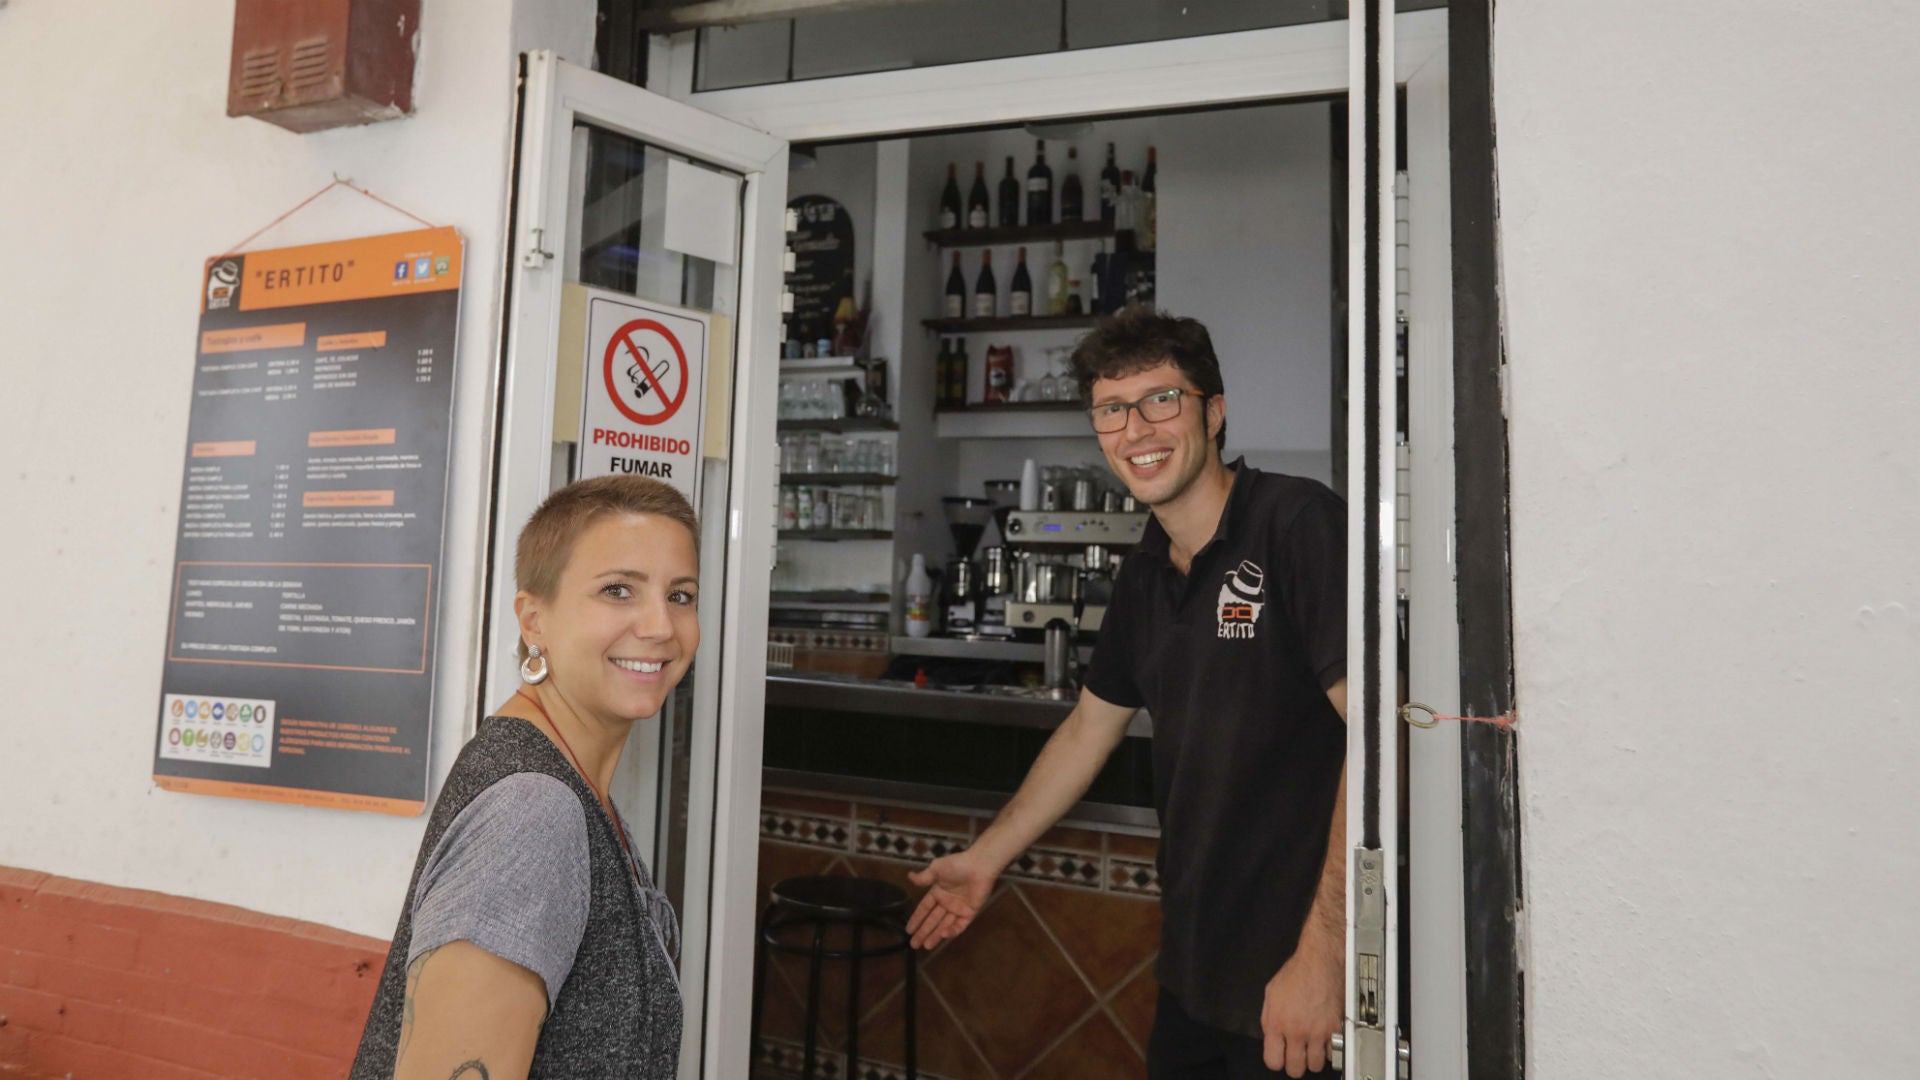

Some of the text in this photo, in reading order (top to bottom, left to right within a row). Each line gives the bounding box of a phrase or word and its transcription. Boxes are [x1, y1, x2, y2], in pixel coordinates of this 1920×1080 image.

[593, 428, 690, 455] PROHIBIDO
[610, 456, 672, 478] FUMAR
[1218, 622, 1254, 639] ERTITO
